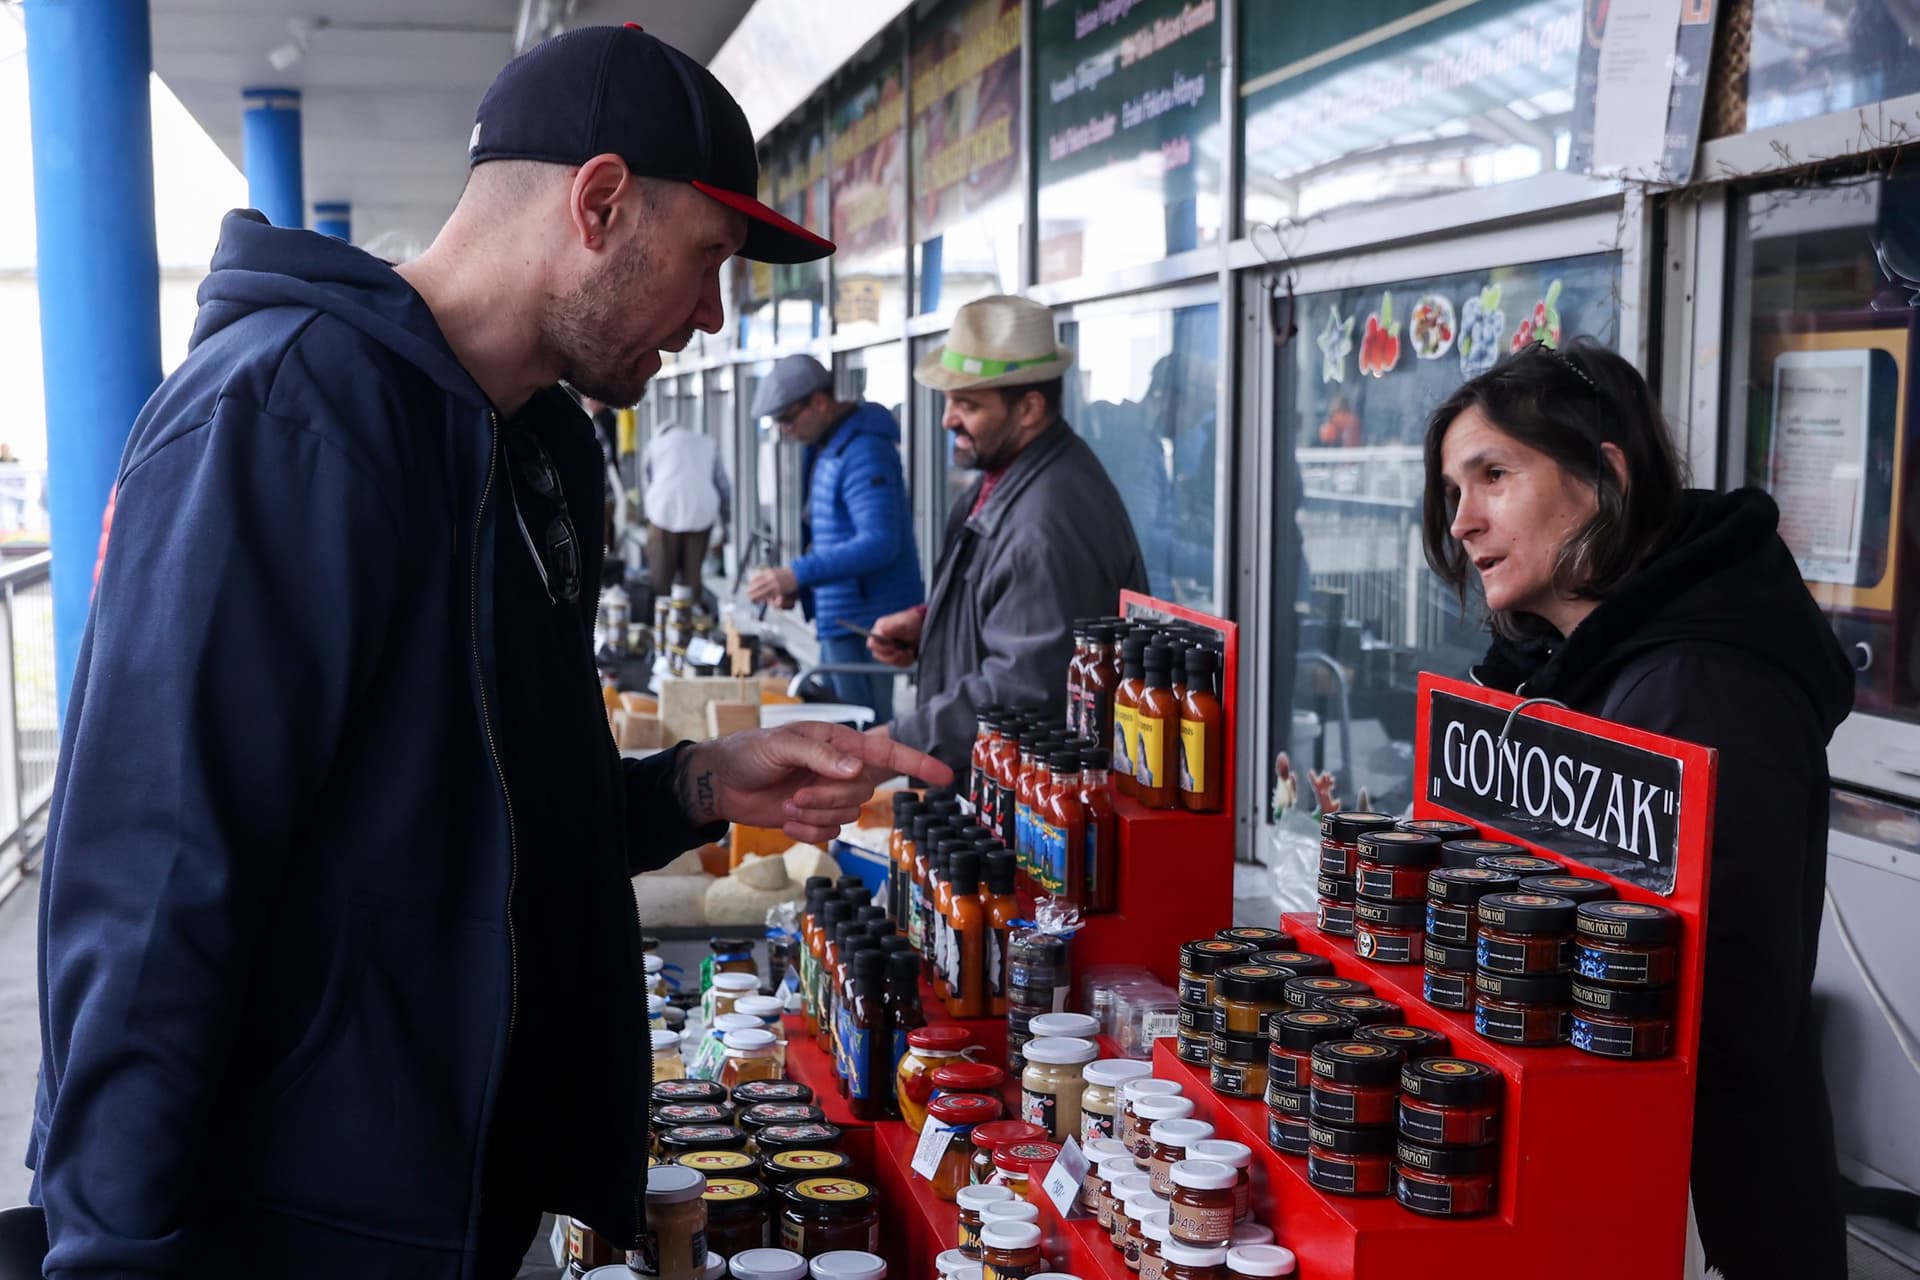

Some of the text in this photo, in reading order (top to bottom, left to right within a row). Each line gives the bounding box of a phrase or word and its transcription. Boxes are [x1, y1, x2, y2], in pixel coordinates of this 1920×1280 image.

[1595, 922, 1608, 934] FOR
[1609, 925, 1625, 936] YOU
[1175, 1211, 1205, 1233] HABA
